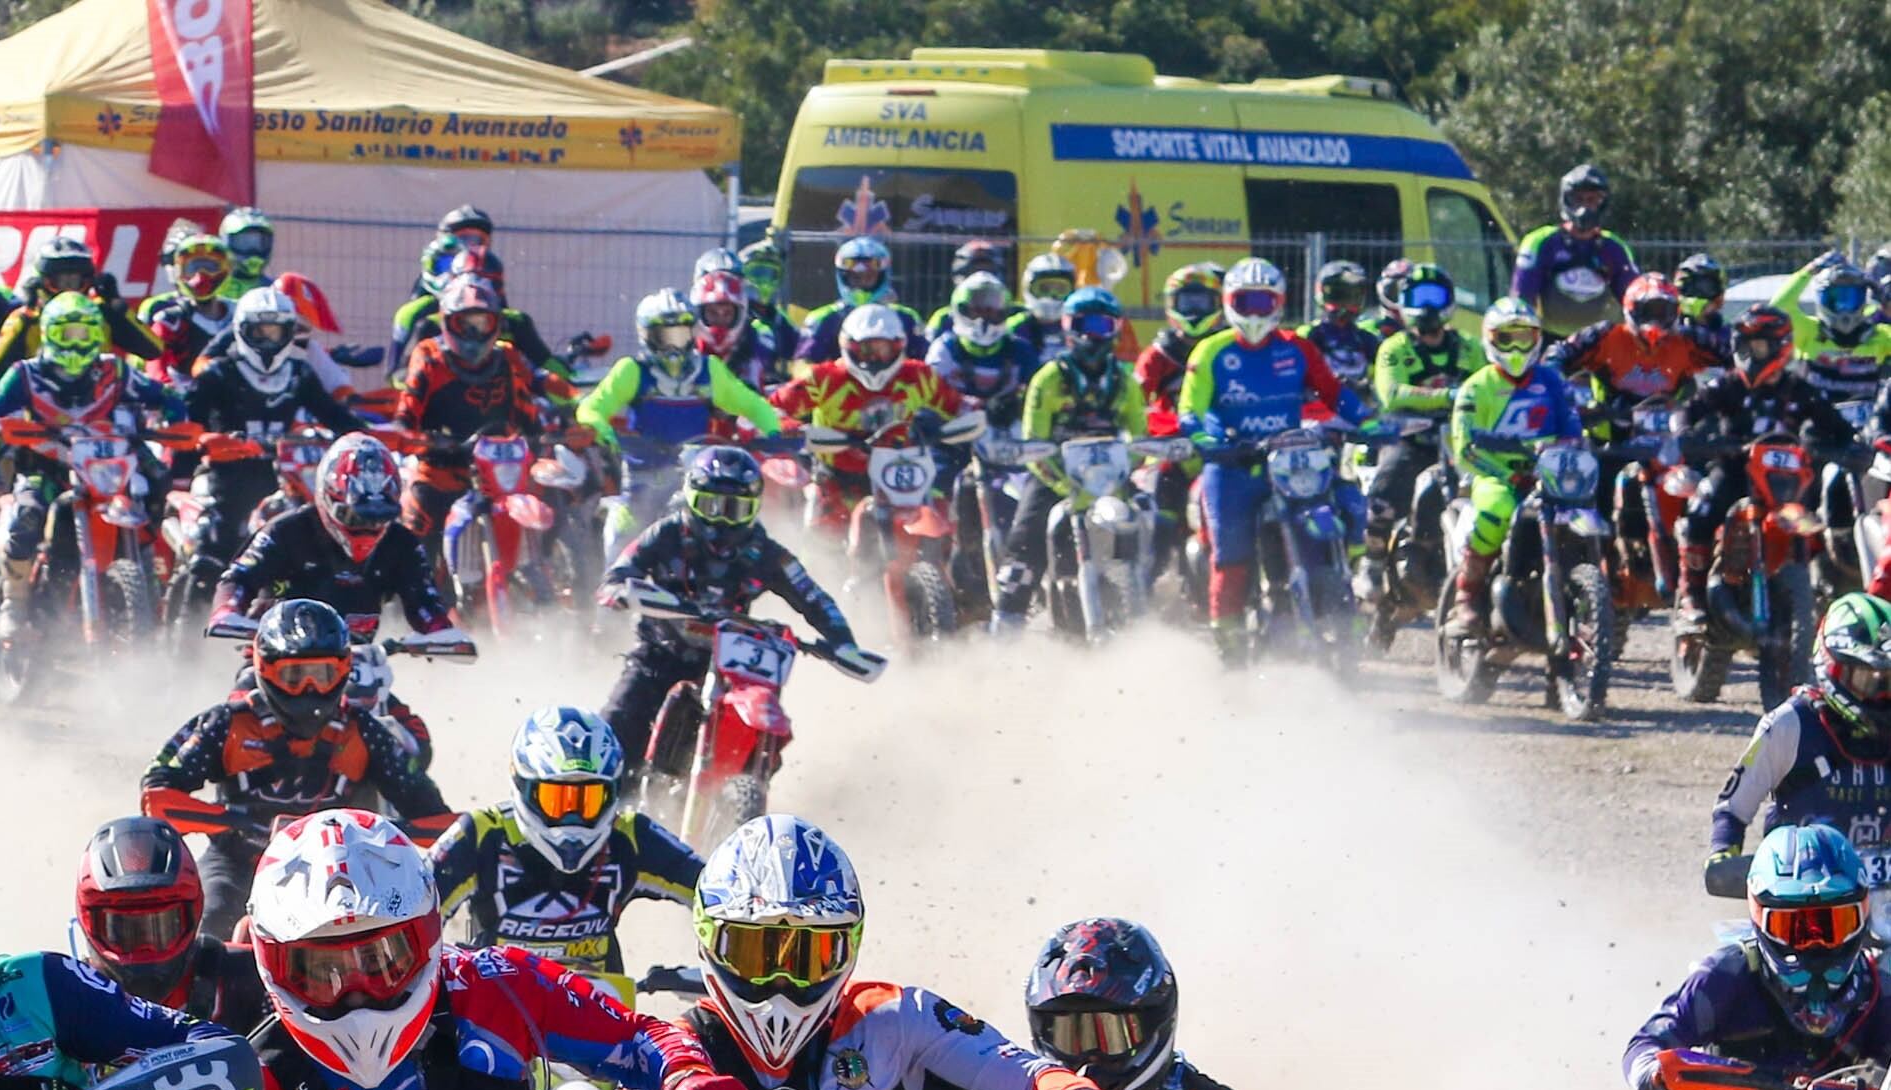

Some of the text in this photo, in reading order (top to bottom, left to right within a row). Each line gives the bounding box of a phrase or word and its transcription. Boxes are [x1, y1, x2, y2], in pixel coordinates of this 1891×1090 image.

[315, 108, 433, 135] Sanitario
[441, 112, 568, 140] Avanzado
[879, 102, 928, 122] SVA
[823, 126, 986, 152] AMBULANCIA
[1112, 128, 1352, 166] SOPORTE VITAL AVANZADO
[748, 646, 763, 665] 3
